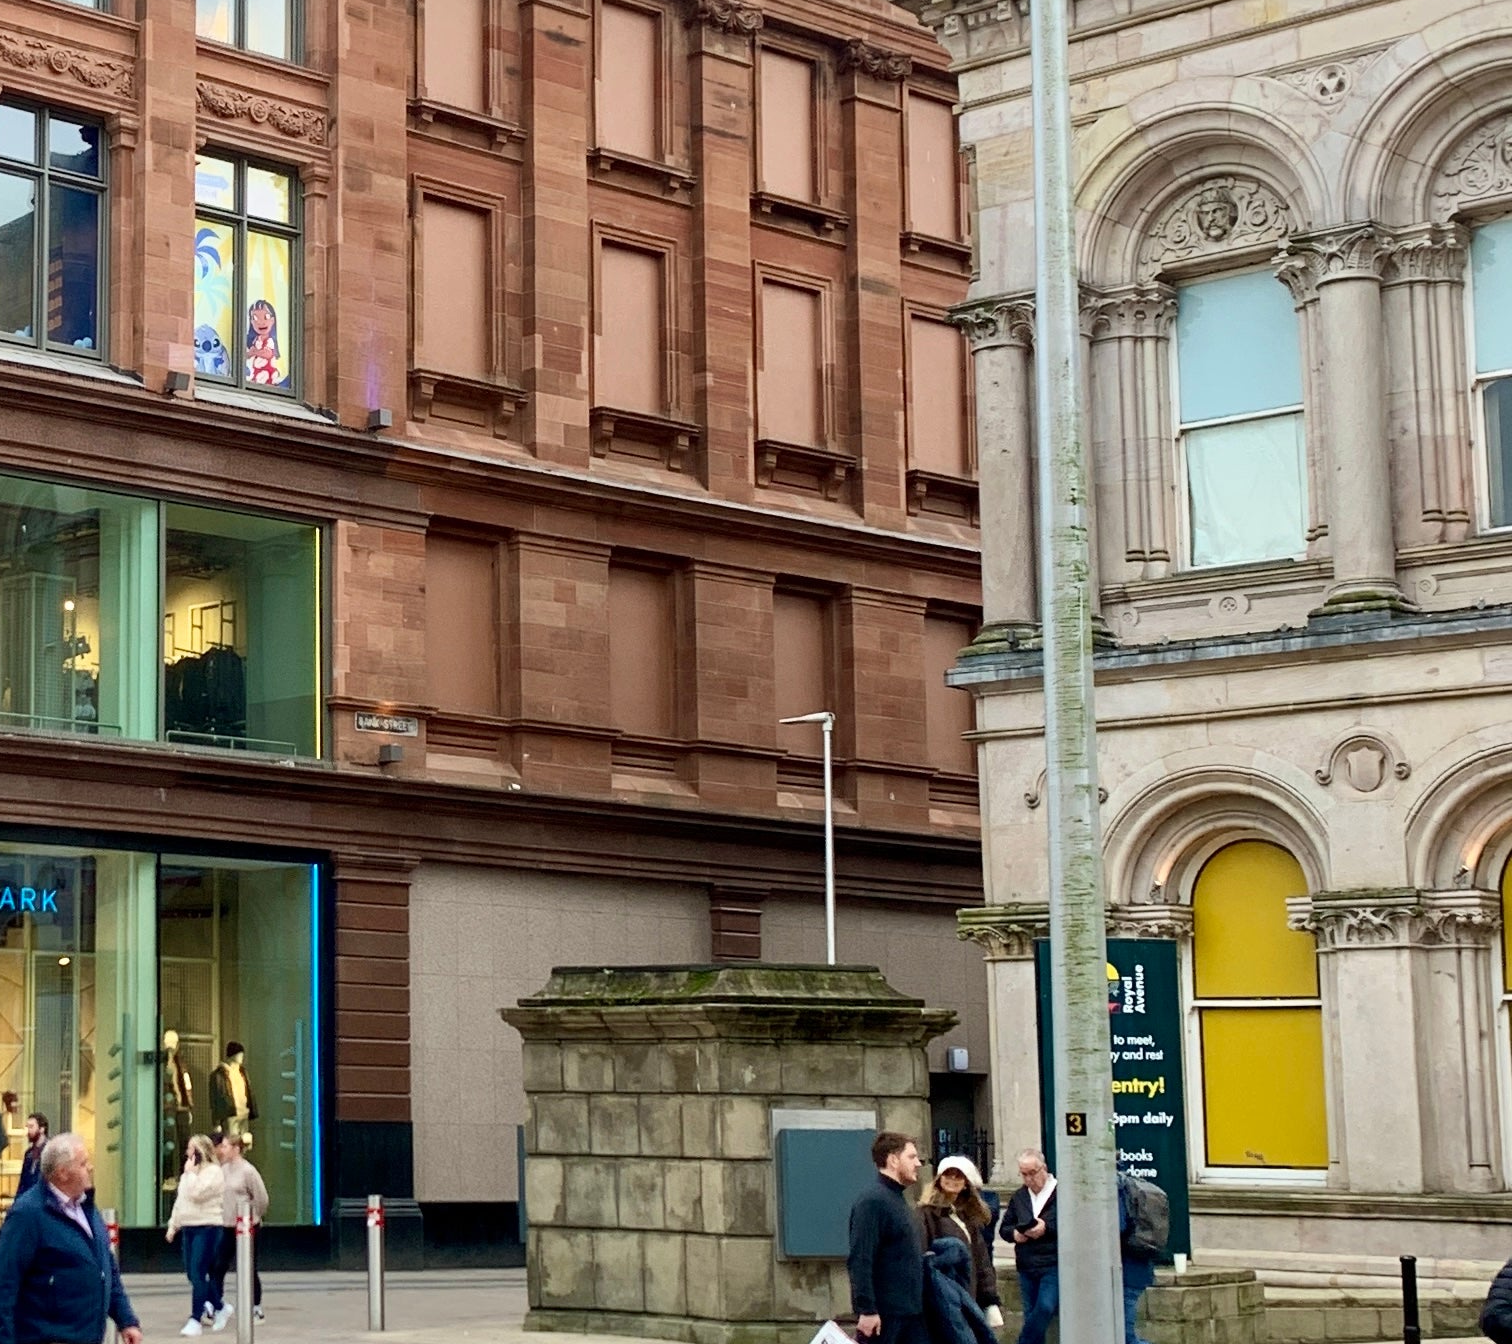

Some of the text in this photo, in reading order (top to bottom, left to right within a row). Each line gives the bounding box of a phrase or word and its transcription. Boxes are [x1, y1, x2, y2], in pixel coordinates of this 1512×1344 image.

[1121, 976, 1136, 1014] Royal
[1134, 964, 1146, 1014] Avenue
[1113, 1034, 1156, 1048] to meet,
[1122, 1047, 1144, 1060] and
[1145, 1049, 1164, 1060] rest
[1111, 1076, 1165, 1098] entry!
[1069, 1114, 1082, 1133] 3
[1142, 1111, 1174, 1127] daily
[1120, 1148, 1154, 1162] books
